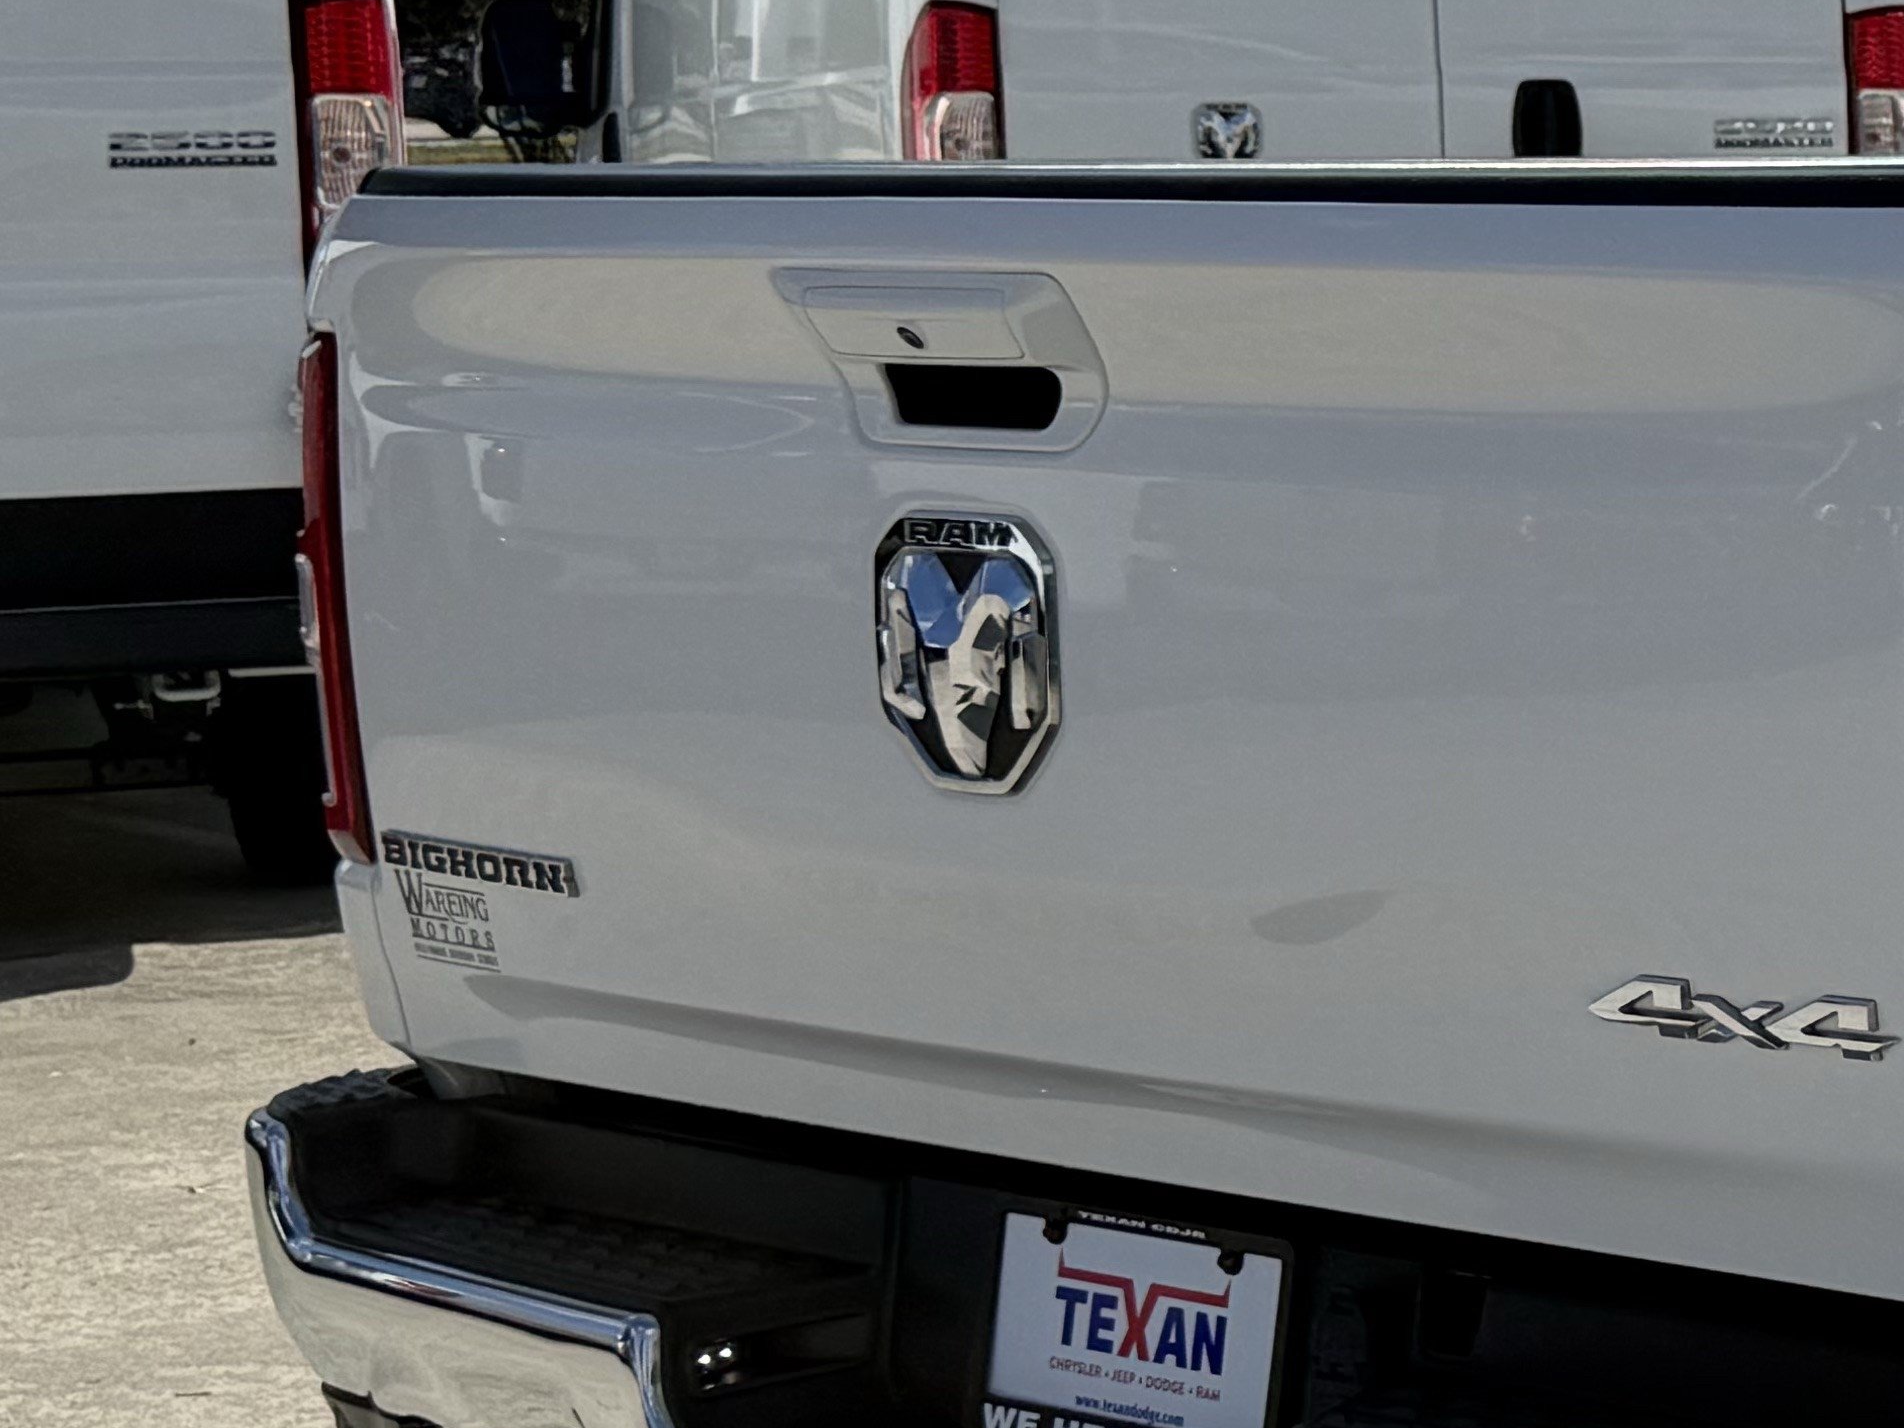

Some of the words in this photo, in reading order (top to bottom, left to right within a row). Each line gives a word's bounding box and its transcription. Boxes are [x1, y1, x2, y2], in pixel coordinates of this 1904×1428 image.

[903, 519, 1017, 547] RAM
[381, 830, 571, 897] BIGHORN
[410, 917, 496, 951] MOTORS
[1077, 1209, 1146, 1230] TEXAN
[1151, 1220, 1207, 1240] CDJR
[1055, 1272, 1230, 1377] TEXAN
[1049, 1356, 1102, 1378] CHRYSLER
[1110, 1368, 1136, 1384] JEEP
[1145, 1375, 1186, 1395] DODGE
[1195, 1386, 1221, 1402] RAM
[1074, 1393, 1185, 1427] www.texandodge.com
